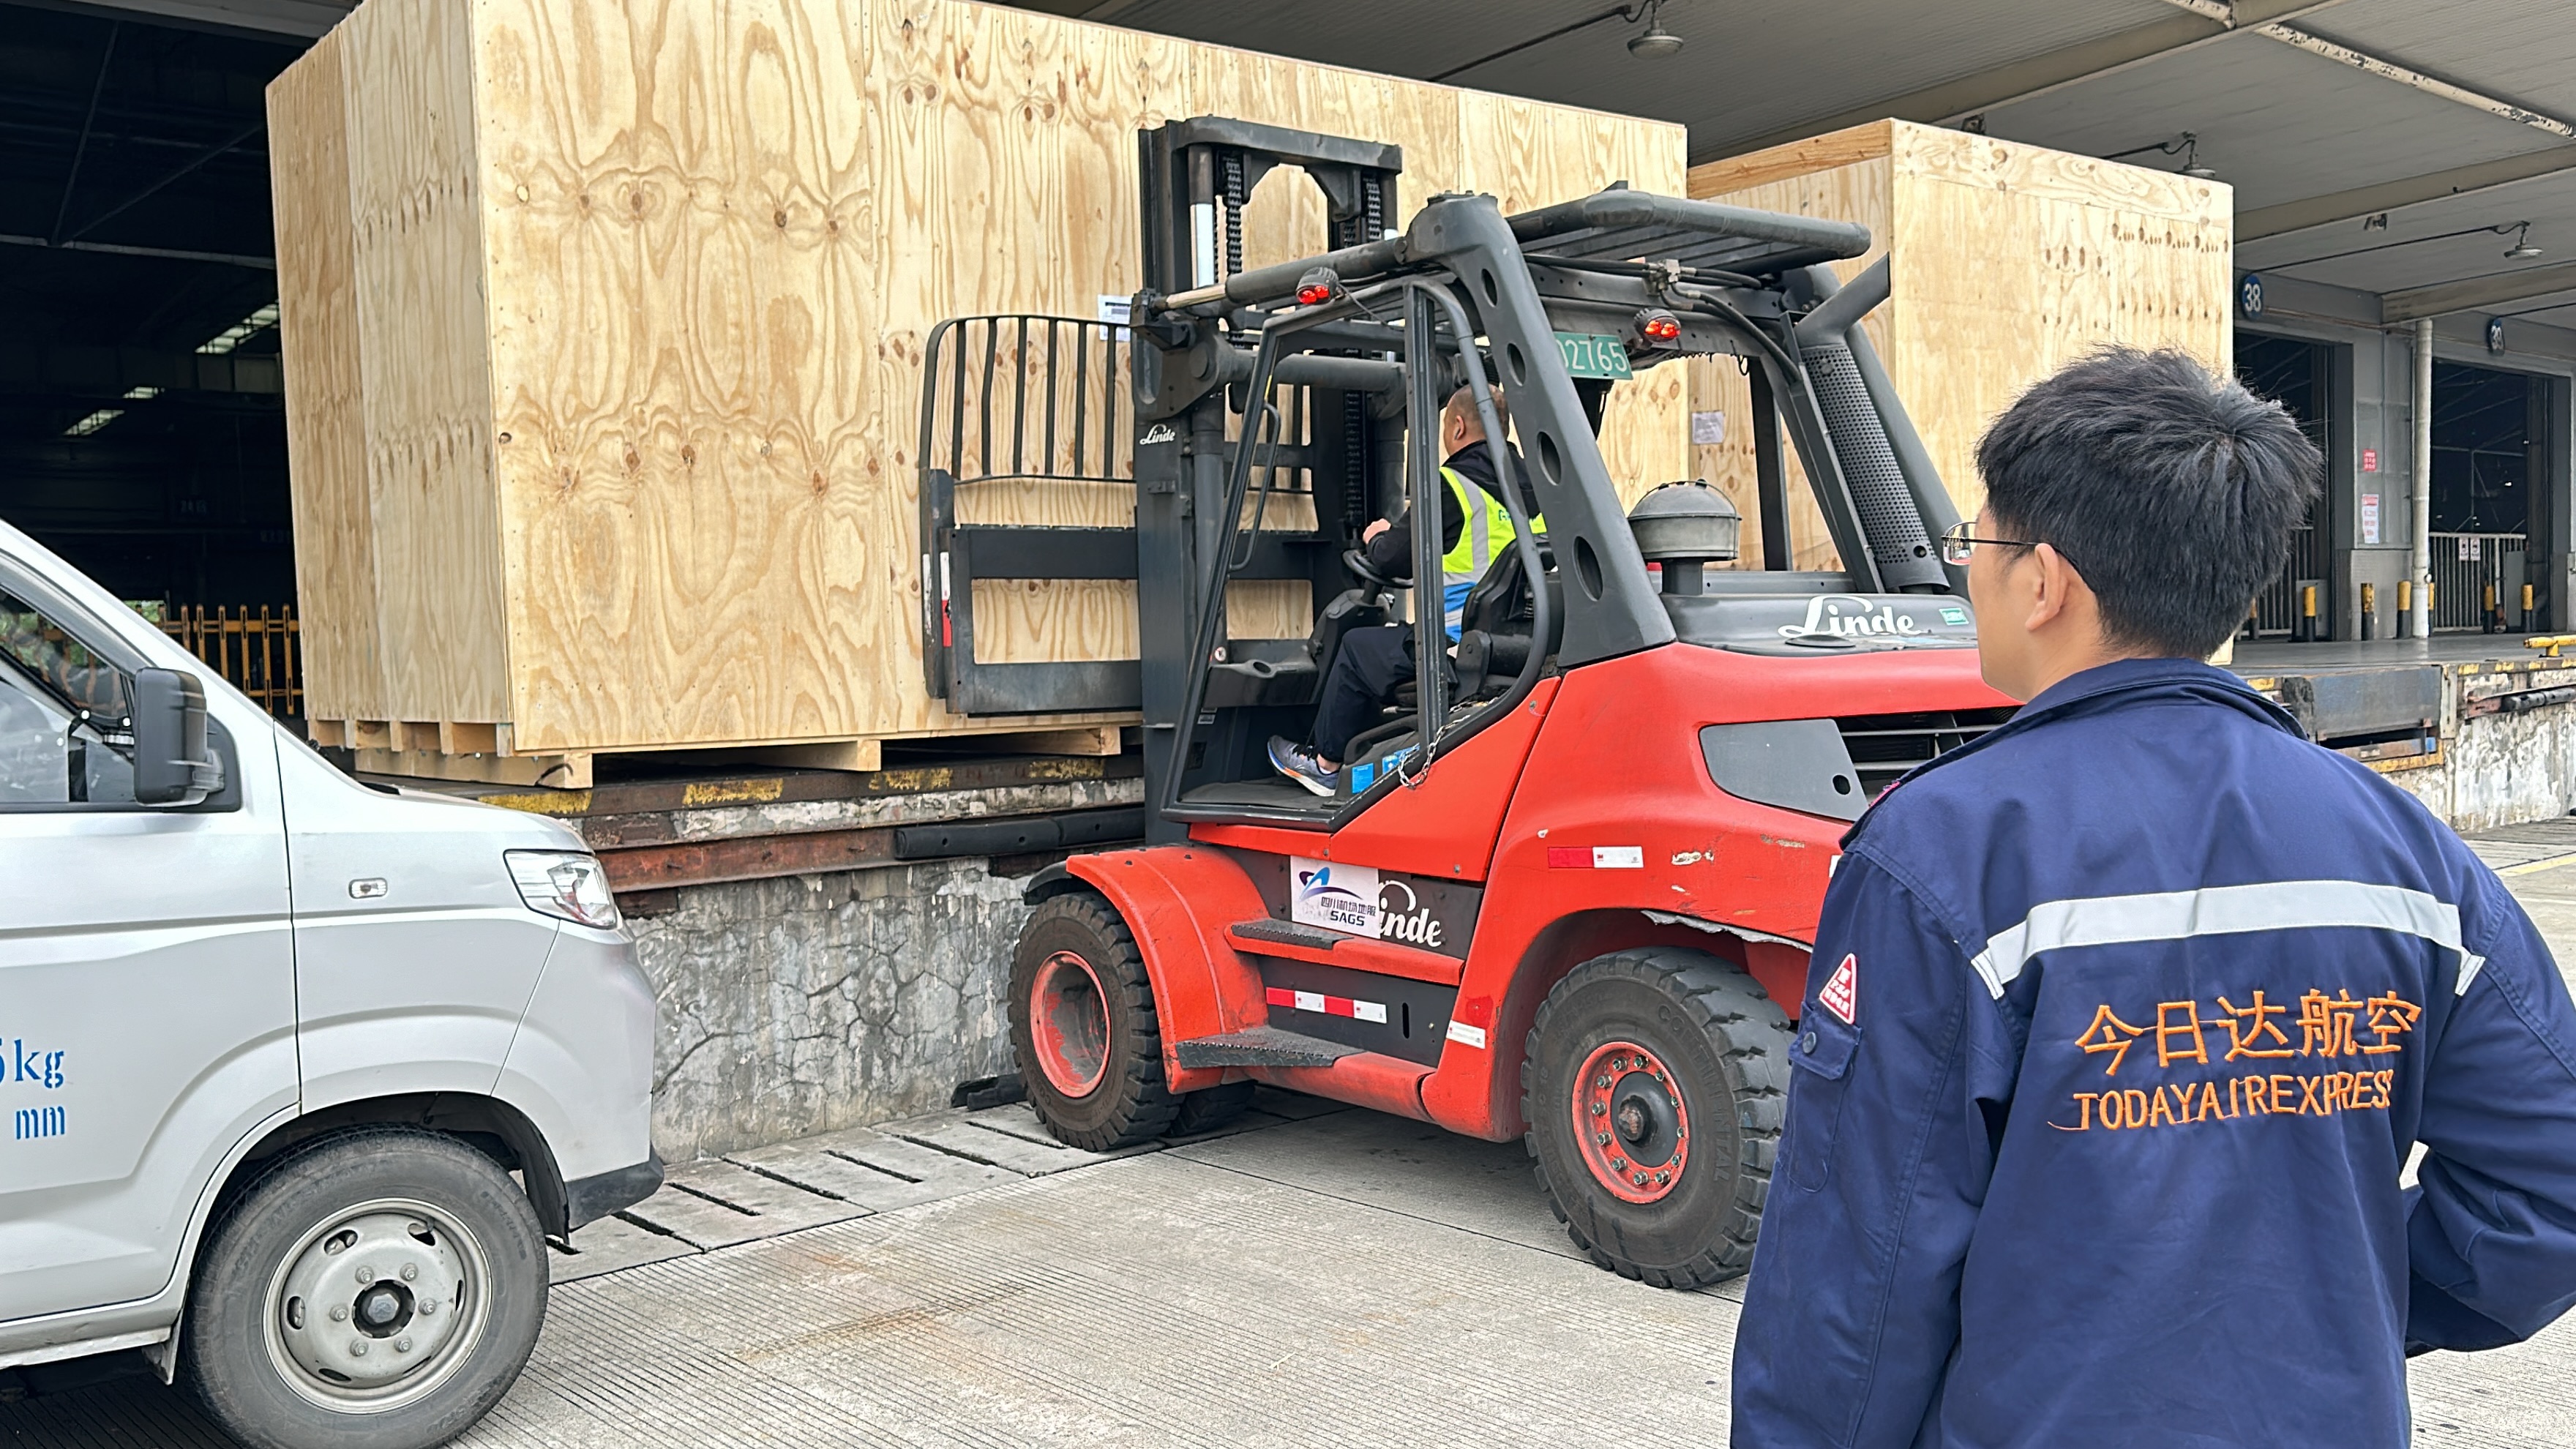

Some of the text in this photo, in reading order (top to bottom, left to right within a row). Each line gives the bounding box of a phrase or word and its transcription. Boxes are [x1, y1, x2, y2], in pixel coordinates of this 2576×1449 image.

[2244, 282, 2262, 312] 38
[1139, 423, 1175, 445] Linde
[1778, 595, 1922, 638] Linde
[1321, 896, 1377, 917] 四川机场地服
[1330, 910, 1366, 926] SAGS
[2074, 988, 2422, 1077] 今日达航空
[15, 1106, 65, 1140] mm
